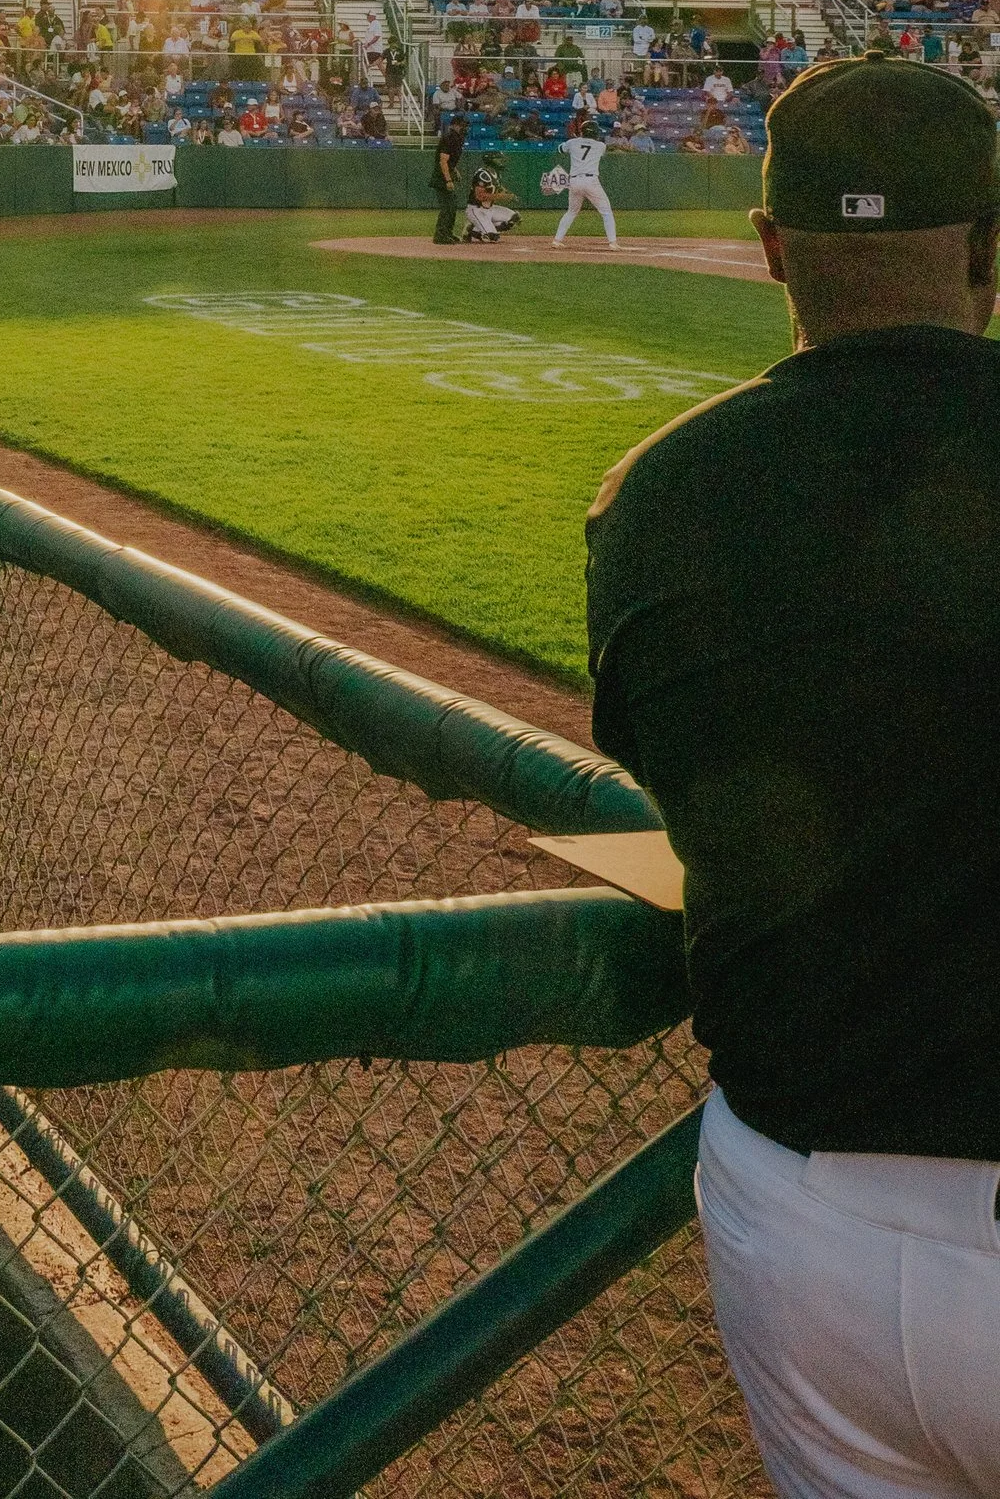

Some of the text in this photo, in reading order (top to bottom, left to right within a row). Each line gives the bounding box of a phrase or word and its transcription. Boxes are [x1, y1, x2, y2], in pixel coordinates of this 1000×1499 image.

[600, 27, 610, 37] 22
[580, 144, 592, 161] 7
[97, 160, 132, 177] MEXICO
[151, 159, 175, 175] TRU
[541, 173, 570, 187] AAB
